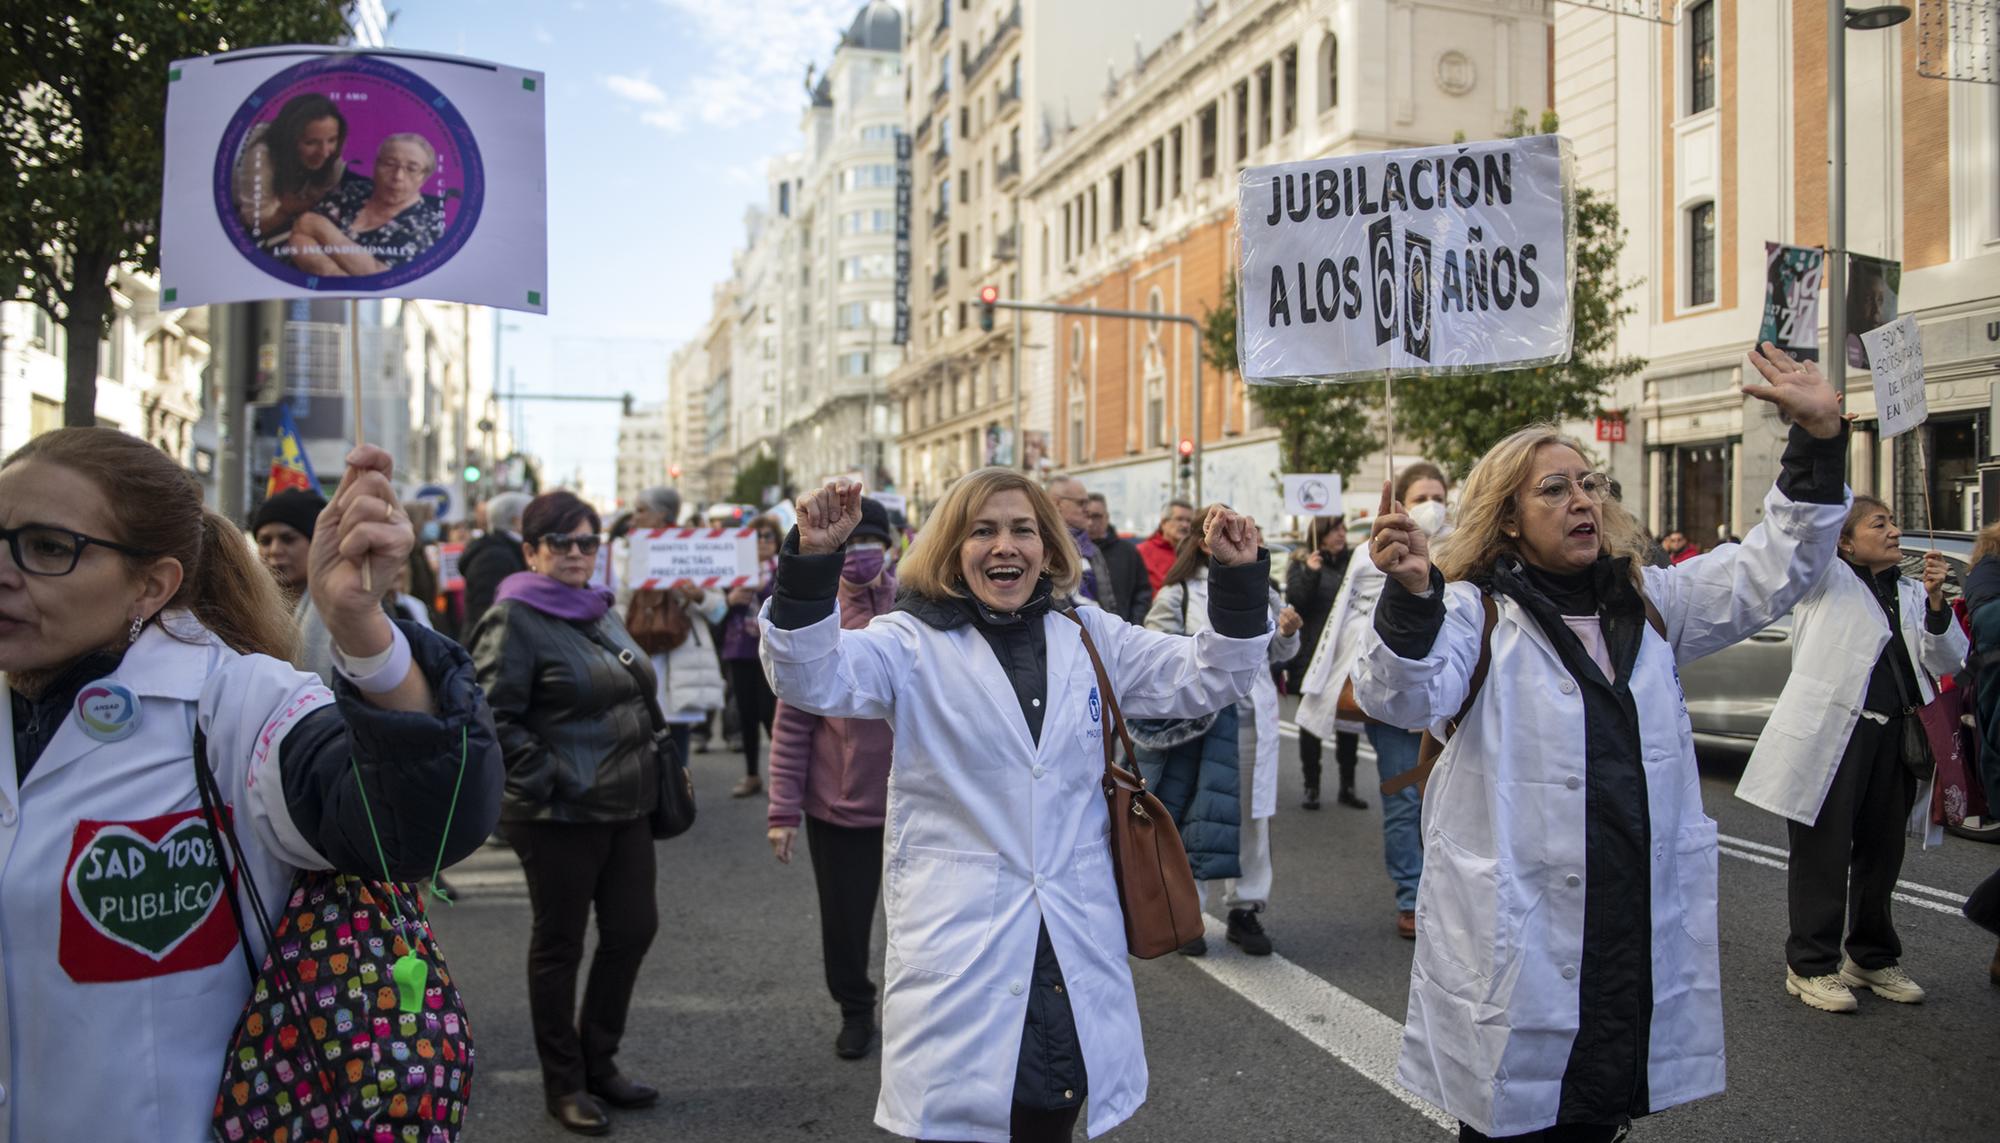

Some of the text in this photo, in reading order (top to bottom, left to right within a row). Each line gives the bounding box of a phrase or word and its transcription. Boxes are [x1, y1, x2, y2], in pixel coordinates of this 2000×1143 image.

[1266, 147, 1513, 227] JUBILACIÓN
[1268, 220, 1540, 356] A LOS 60 AÑOS
[1888, 381, 1899, 396] DE
[1887, 403, 1901, 420] EN
[650, 566, 735, 576] PRECARIEDADES
[86, 837, 220, 881] SAD 100%
